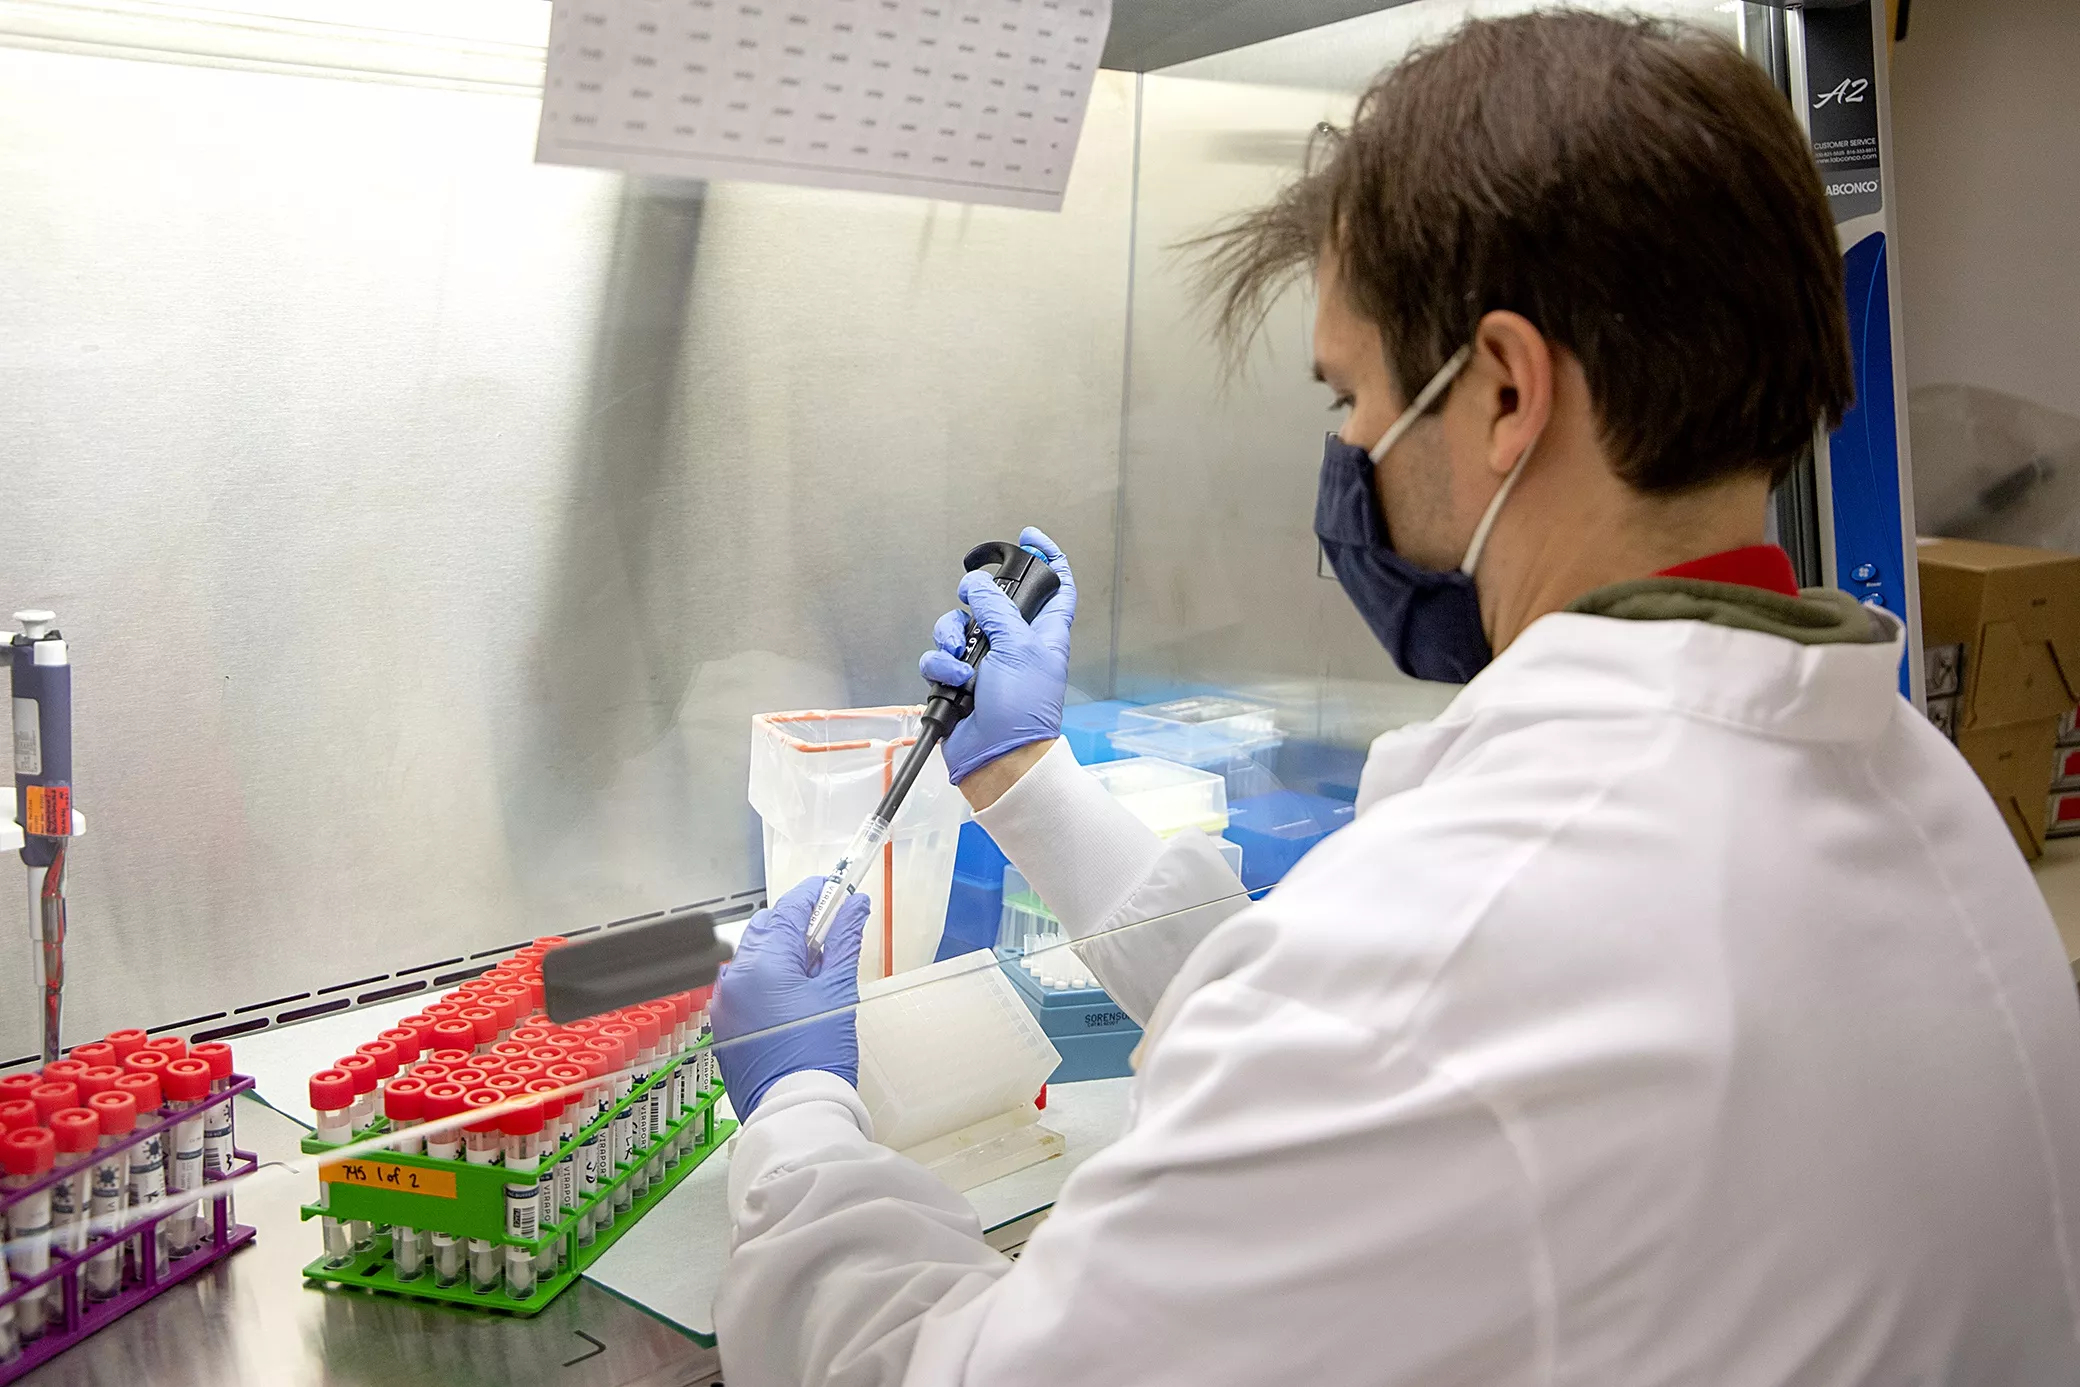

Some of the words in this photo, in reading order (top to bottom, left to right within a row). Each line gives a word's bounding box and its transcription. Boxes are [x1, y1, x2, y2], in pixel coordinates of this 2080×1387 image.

[1813, 78, 1869, 109] A2
[1813, 140, 1849, 150] CUSTOMER
[1849, 137, 1876, 147] SERVICE
[1824, 180, 1878, 196] ABCONCO
[809, 885, 835, 927] VIRAPORT
[1084, 1011, 1131, 1024] SORENSO
[342, 1165, 367, 1181] 745
[377, 1167, 383, 1182] 1
[387, 1167, 401, 1185] of
[409, 1173, 420, 1188] 2
